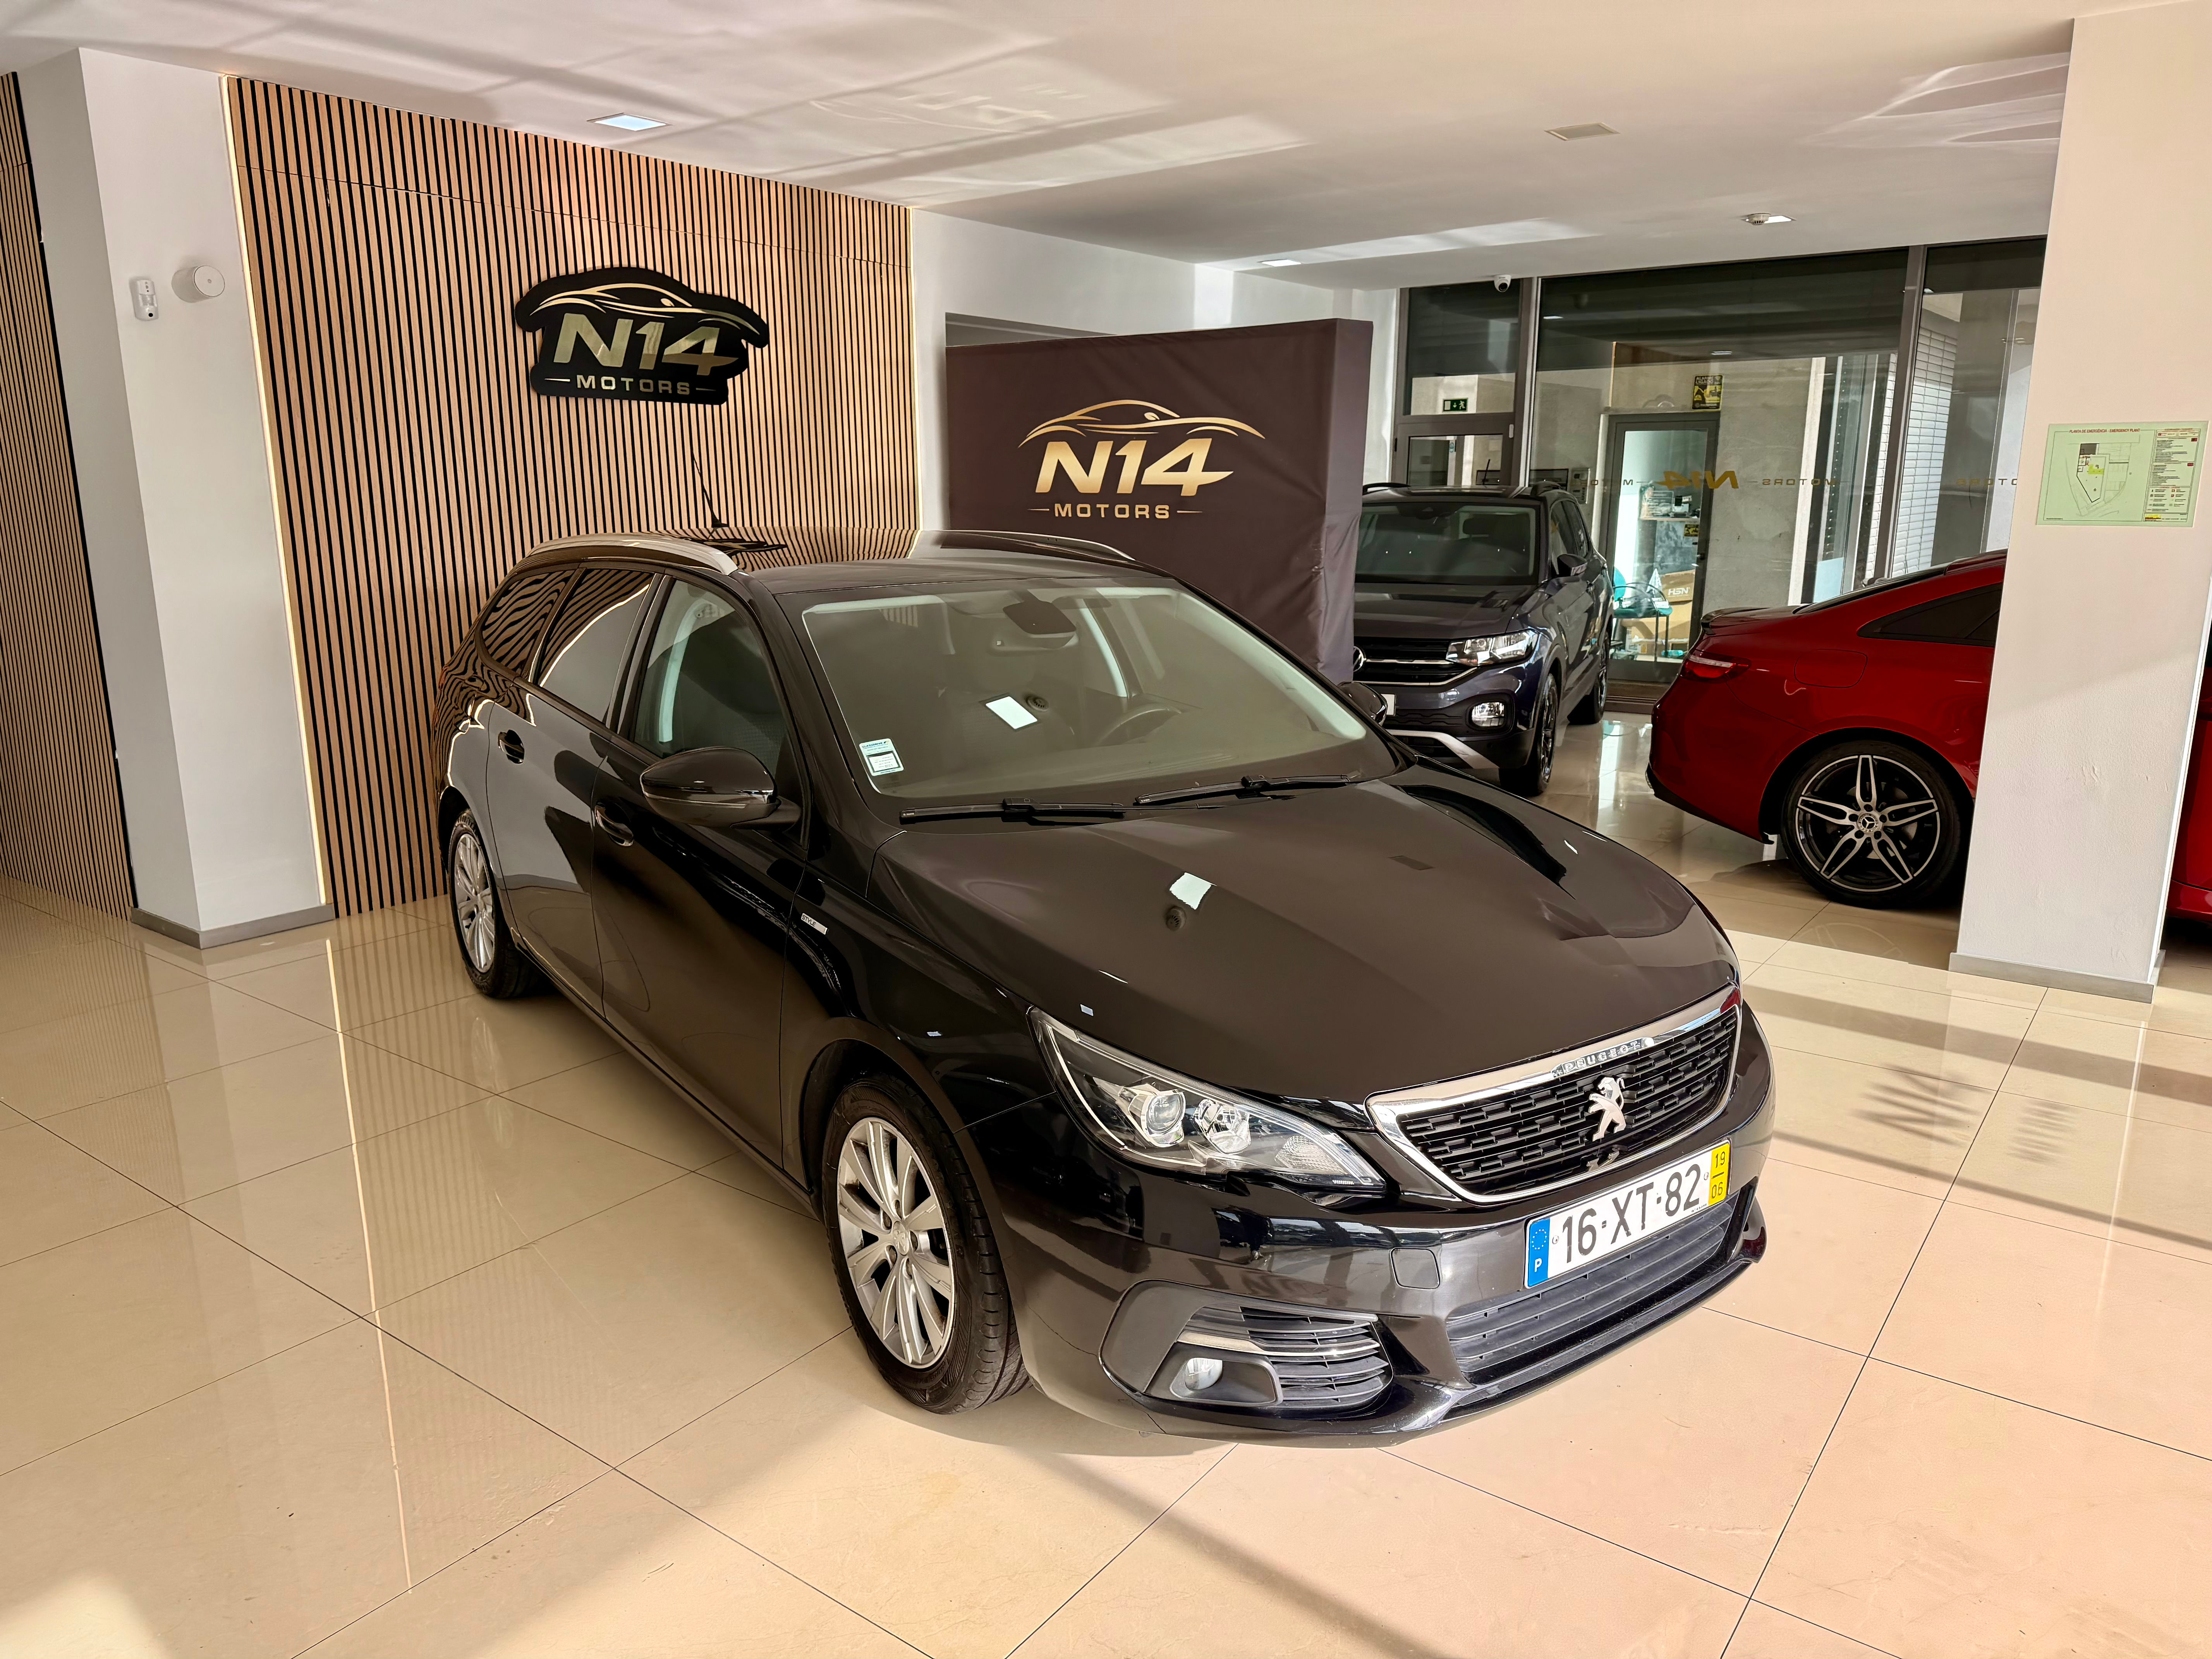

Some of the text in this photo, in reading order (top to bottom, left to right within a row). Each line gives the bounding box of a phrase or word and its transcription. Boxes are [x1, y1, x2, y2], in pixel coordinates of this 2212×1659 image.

[553, 313, 738, 375] N14
[577, 374, 690, 395] MOTORS
[1036, 438, 1234, 496] N14
[1054, 503, 1170, 519] MOTORS
[1668, 587, 1689, 595] HSN
[802, 915, 816, 927] STYLE
[1565, 1041, 1638, 1073] PEUGEOT
[1716, 1151, 1726, 1168] 19
[1711, 1184, 1723, 1199] 06
[1534, 1258, 1542, 1273] P
